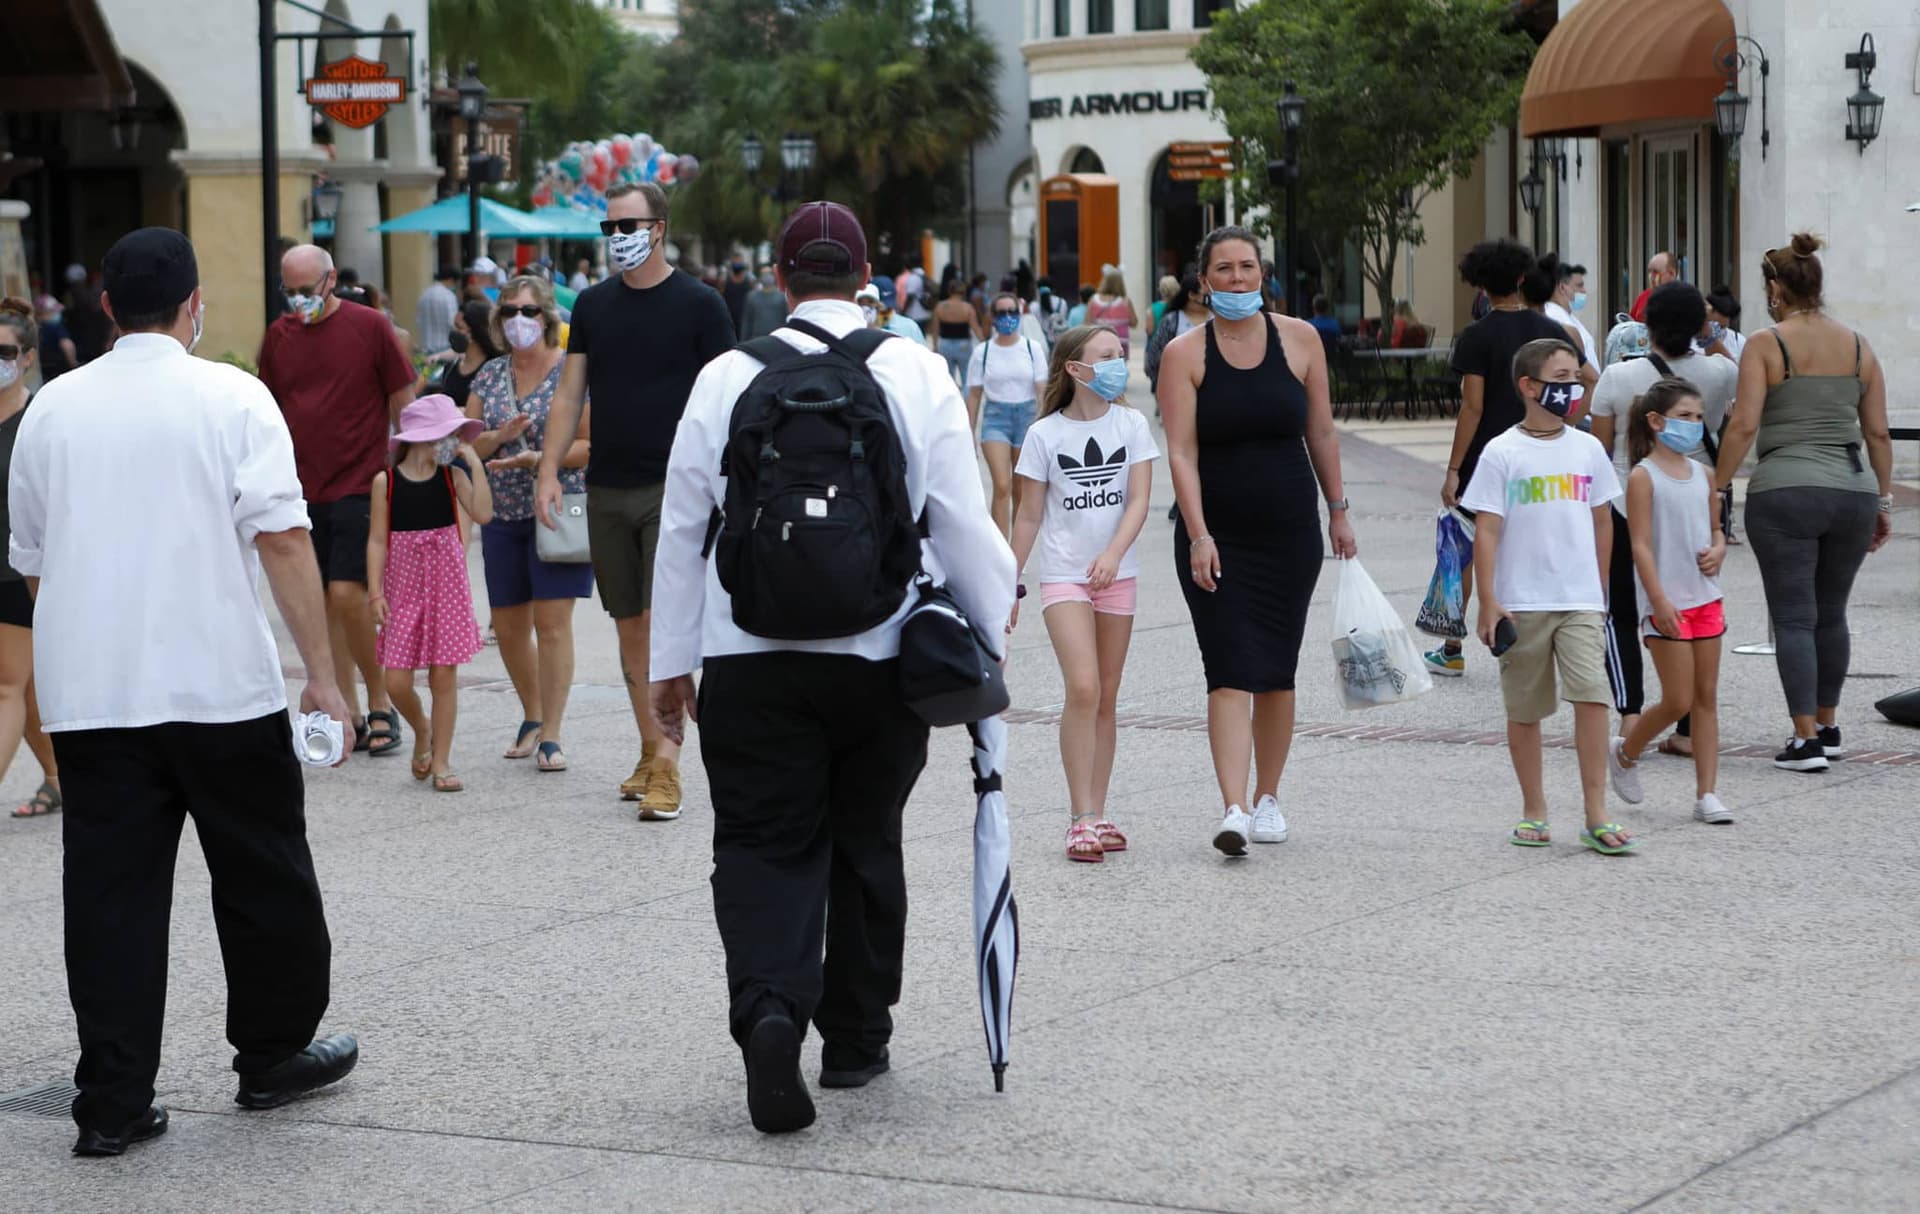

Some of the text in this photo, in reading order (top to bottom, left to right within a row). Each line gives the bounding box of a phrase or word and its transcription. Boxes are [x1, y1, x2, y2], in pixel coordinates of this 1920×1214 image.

[312, 82, 400, 99] HARLEY-DAVIDSON
[1069, 89, 1208, 118] ARMOUR
[1506, 472, 1593, 506] FORTNIT
